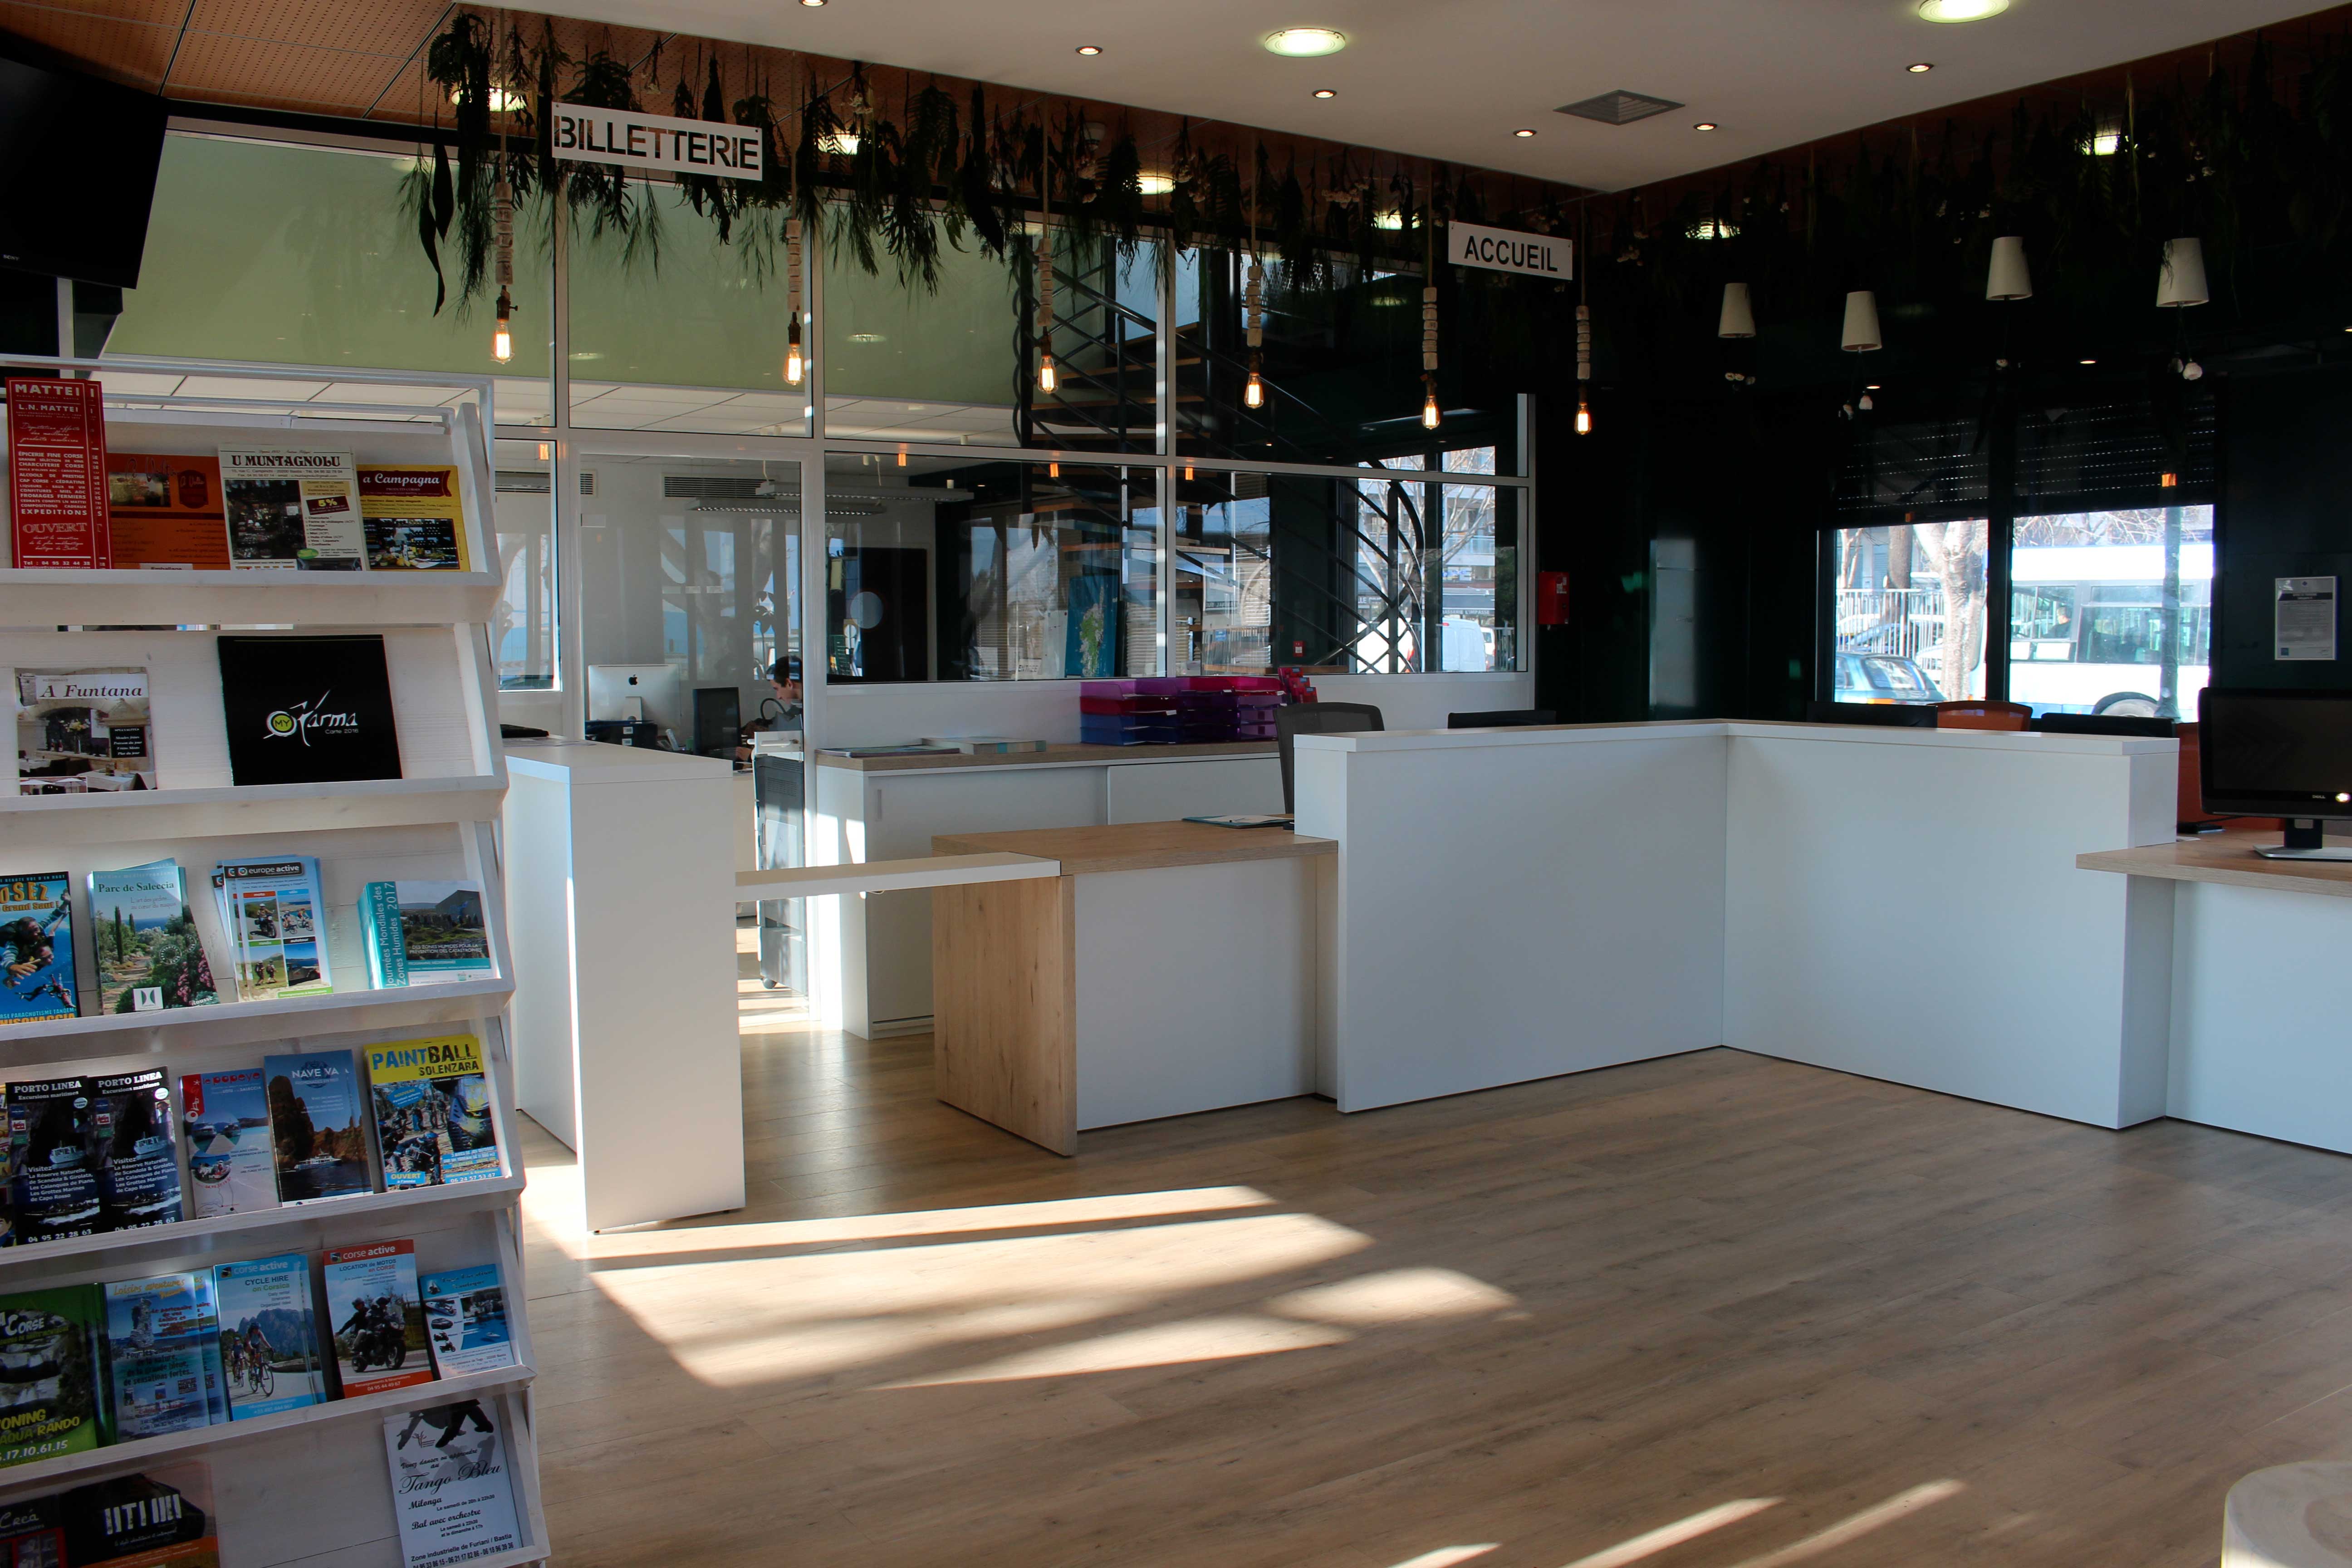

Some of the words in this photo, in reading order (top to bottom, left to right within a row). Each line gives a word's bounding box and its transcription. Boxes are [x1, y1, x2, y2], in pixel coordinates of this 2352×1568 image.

[554, 115, 759, 170] BILLETTERIE
[1464, 235, 1558, 272] ACCUEIL
[15, 384, 79, 396] MATTEI
[231, 456, 241, 466] U
[245, 456, 340, 467] MUNTAGNOLU
[375, 473, 440, 487] Campagna
[318, 499, 337, 507] 5%
[23, 523, 87, 533] OUVERT
[40, 685, 56, 697] A
[64, 685, 142, 697] Funtana
[274, 719, 290, 727] MY
[289, 690, 358, 746] Karma
[249, 866, 275, 874] europe
[276, 865, 299, 873] active
[98, 884, 120, 892] Parc
[137, 882, 174, 891] Saleccia
[385, 883, 397, 910] 2017
[3, 903, 31, 911] Grand
[375, 902, 388, 946] Mondiales
[390, 918, 401, 955] Humides
[383, 949, 397, 986] Journées
[397, 958, 406, 985] Zones
[11, 1009, 52, 1018] PARACHUTISME
[372, 1044, 477, 1070] PAINTBALL
[292, 1068, 322, 1078] NAVE
[419, 1061, 479, 1076] SOLENZARA
[98, 1077, 132, 1088] PORTO
[133, 1071, 163, 1083] LINEA
[213, 1073, 260, 1085] popeye
[14, 1083, 49, 1094] PORTO
[51, 1080, 82, 1090] LINEA
[132, 1082, 160, 1090] maritimes
[144, 1157, 168, 1166] Naturelle
[39, 1182, 71, 1190] Calanques
[343, 1250, 366, 1259] corse
[368, 1245, 395, 1255] active
[234, 1264, 258, 1275] corse
[260, 1260, 288, 1271] active
[339, 1263, 368, 1271] LOCATION
[245, 1277, 270, 1285] CYCLE
[114, 1284, 142, 1296] Loisirs
[37, 1416, 80, 1436] RANDO
[449, 1449, 477, 1459] apprendre
[399, 1472, 452, 1495] Tango
[458, 1460, 501, 1480] Bleu
[408, 1498, 442, 1509] Milonga
[412, 1519, 427, 1530] Bal
[429, 1517, 446, 1525] avec
[448, 1509, 481, 1521] orchestre
[451, 1527, 471, 1535] dimanche
[470, 1539, 490, 1548] Furiani
[494, 1534, 512, 1542] Bastia
